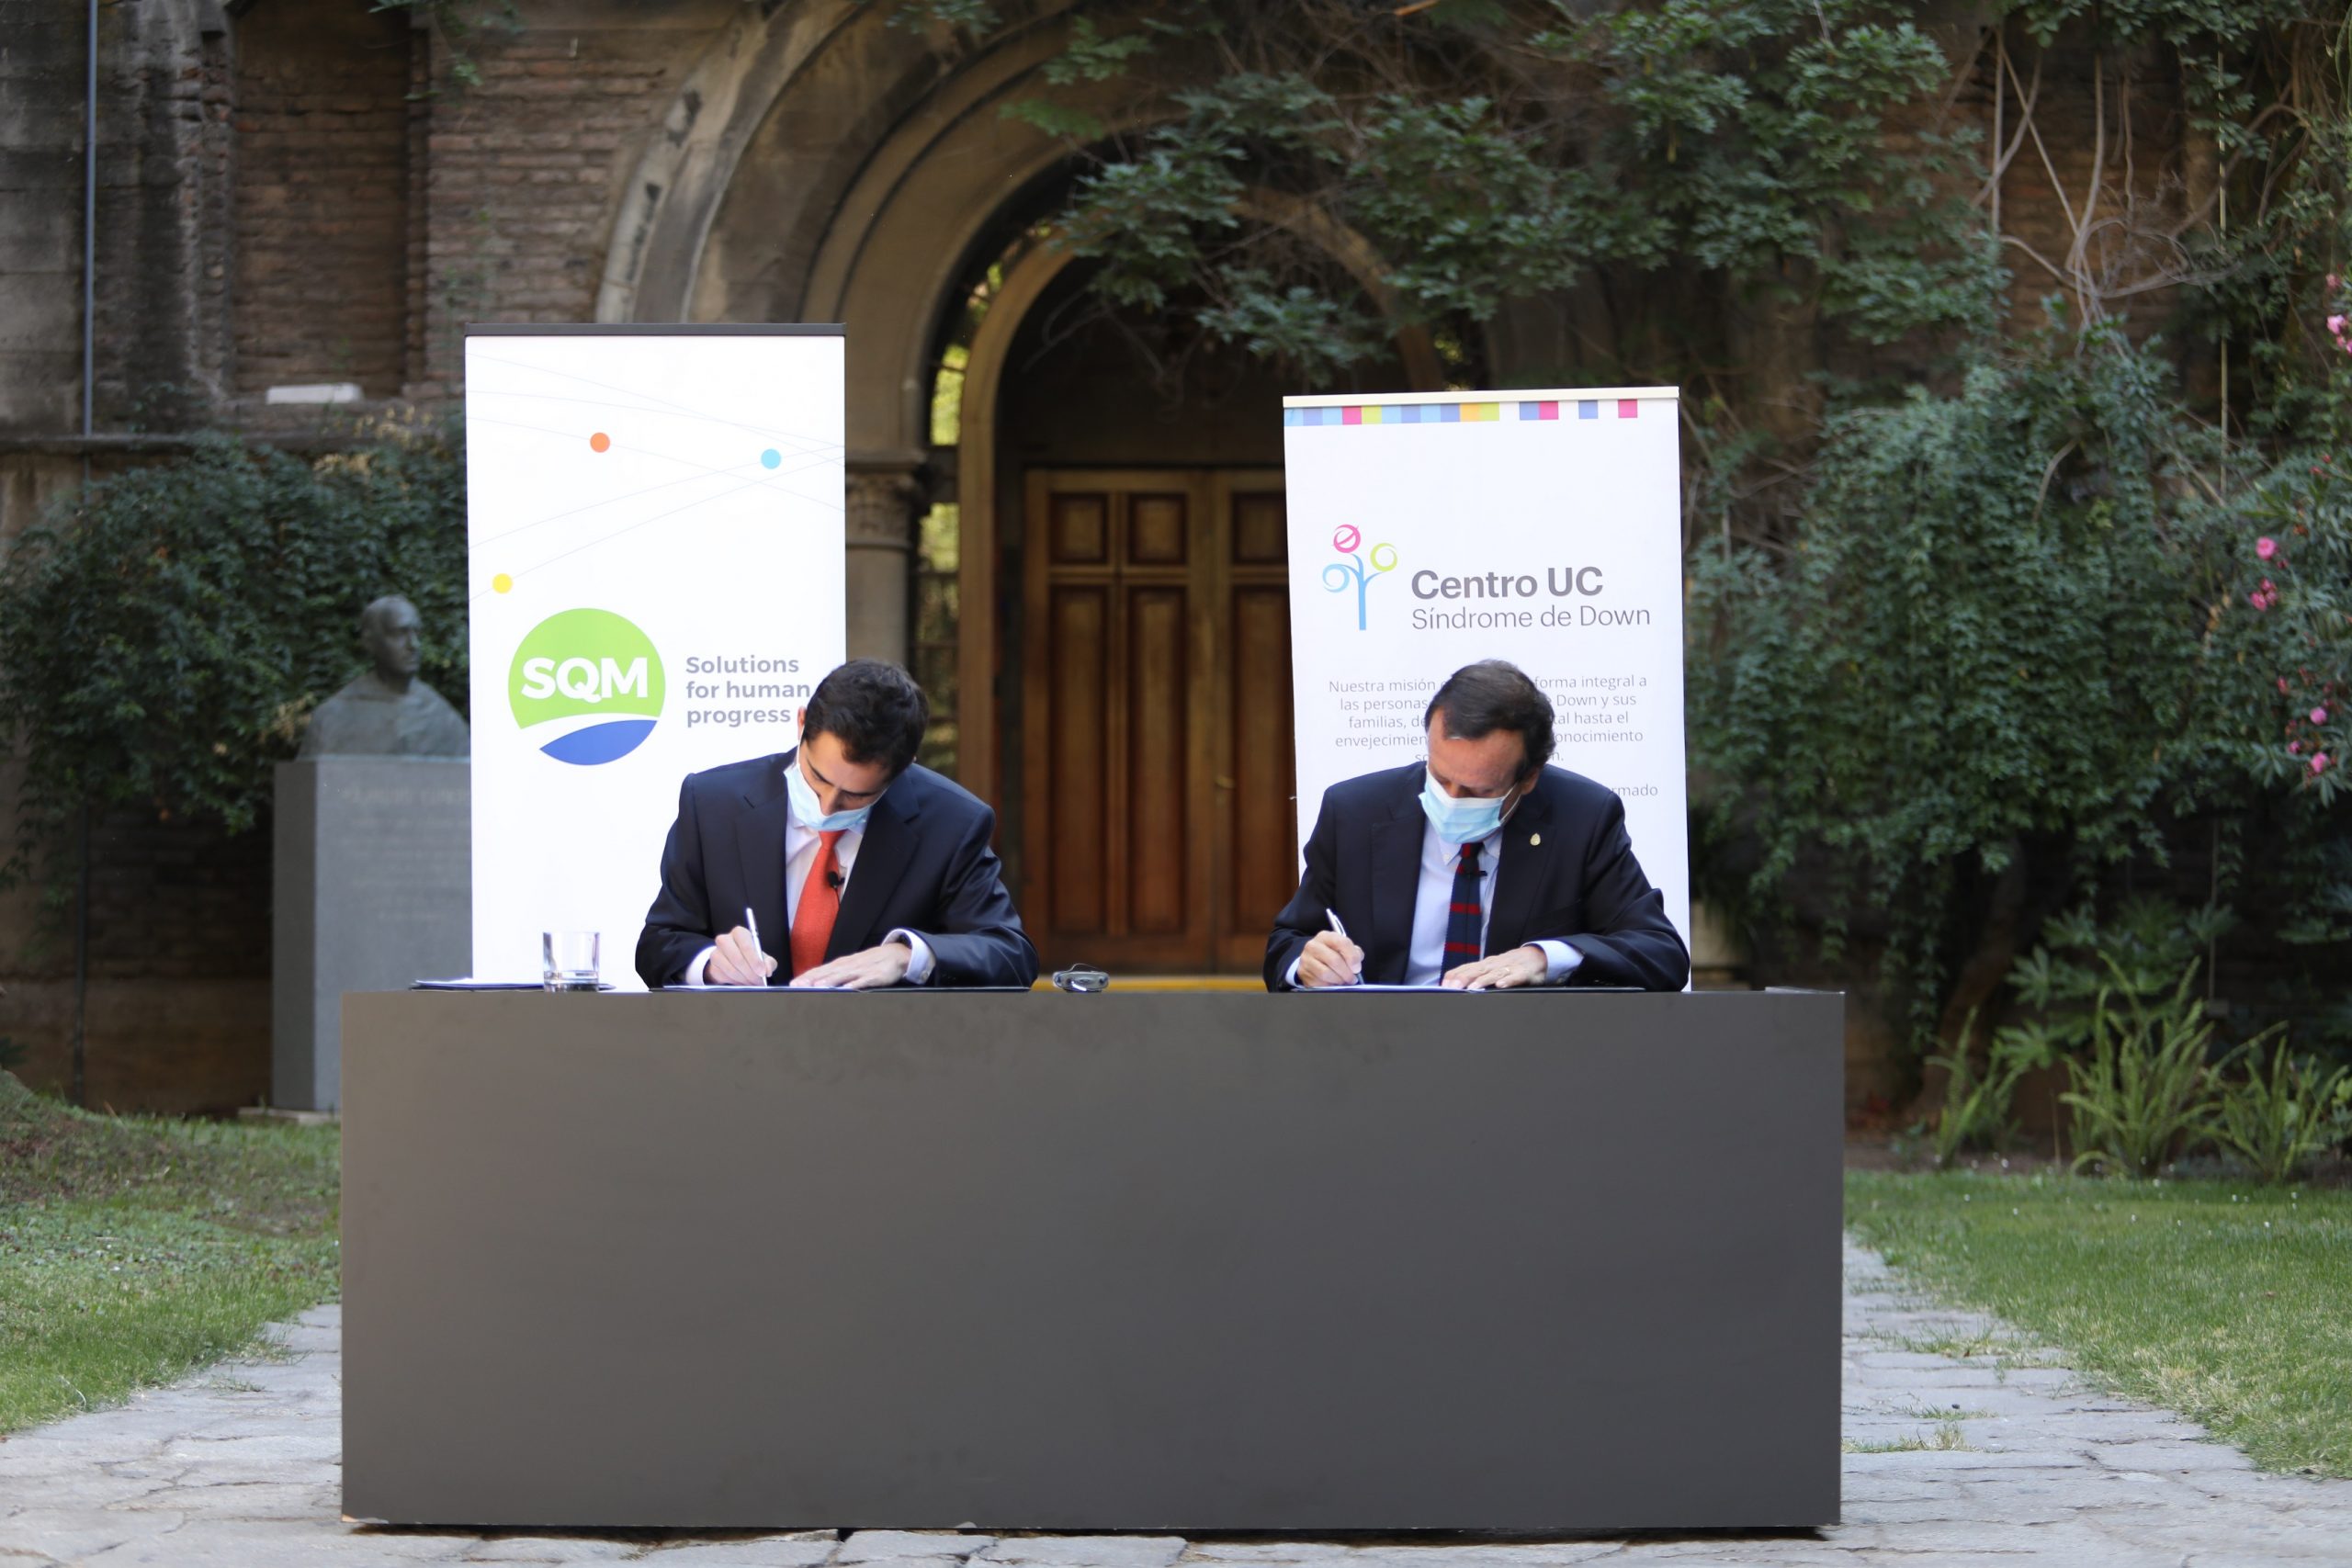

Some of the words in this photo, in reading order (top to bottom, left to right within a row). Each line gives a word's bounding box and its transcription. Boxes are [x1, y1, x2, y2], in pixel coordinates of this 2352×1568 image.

[1411, 569, 1538, 600] Centro
[1547, 566, 1603, 598] UC
[1412, 606, 1532, 630] Síndrome
[1540, 604, 1572, 627] de
[1579, 604, 1651, 626] Down
[685, 655, 800, 674] Solutions
[521, 657, 649, 704] SQM
[1329, 681, 1385, 693] Nuestra
[1389, 678, 1436, 692] misión
[1534, 676, 1577, 688] forma
[1581, 674, 1634, 690] integral
[1639, 677, 1647, 687] a
[685, 680, 719, 700] for
[726, 680, 811, 699] human
[1340, 697, 1360, 710] las
[1363, 699, 1429, 714] personas
[1556, 694, 1597, 706] Down
[1600, 696, 1609, 709] y
[1612, 694, 1637, 706] sus
[686, 705, 792, 728] progress
[1349, 716, 1407, 729] familias,
[1574, 712, 1612, 725] hasta
[1616, 711, 1629, 724] el
[1335, 734, 1428, 750] envejecimien
[1555, 729, 1644, 743] onocimiento
